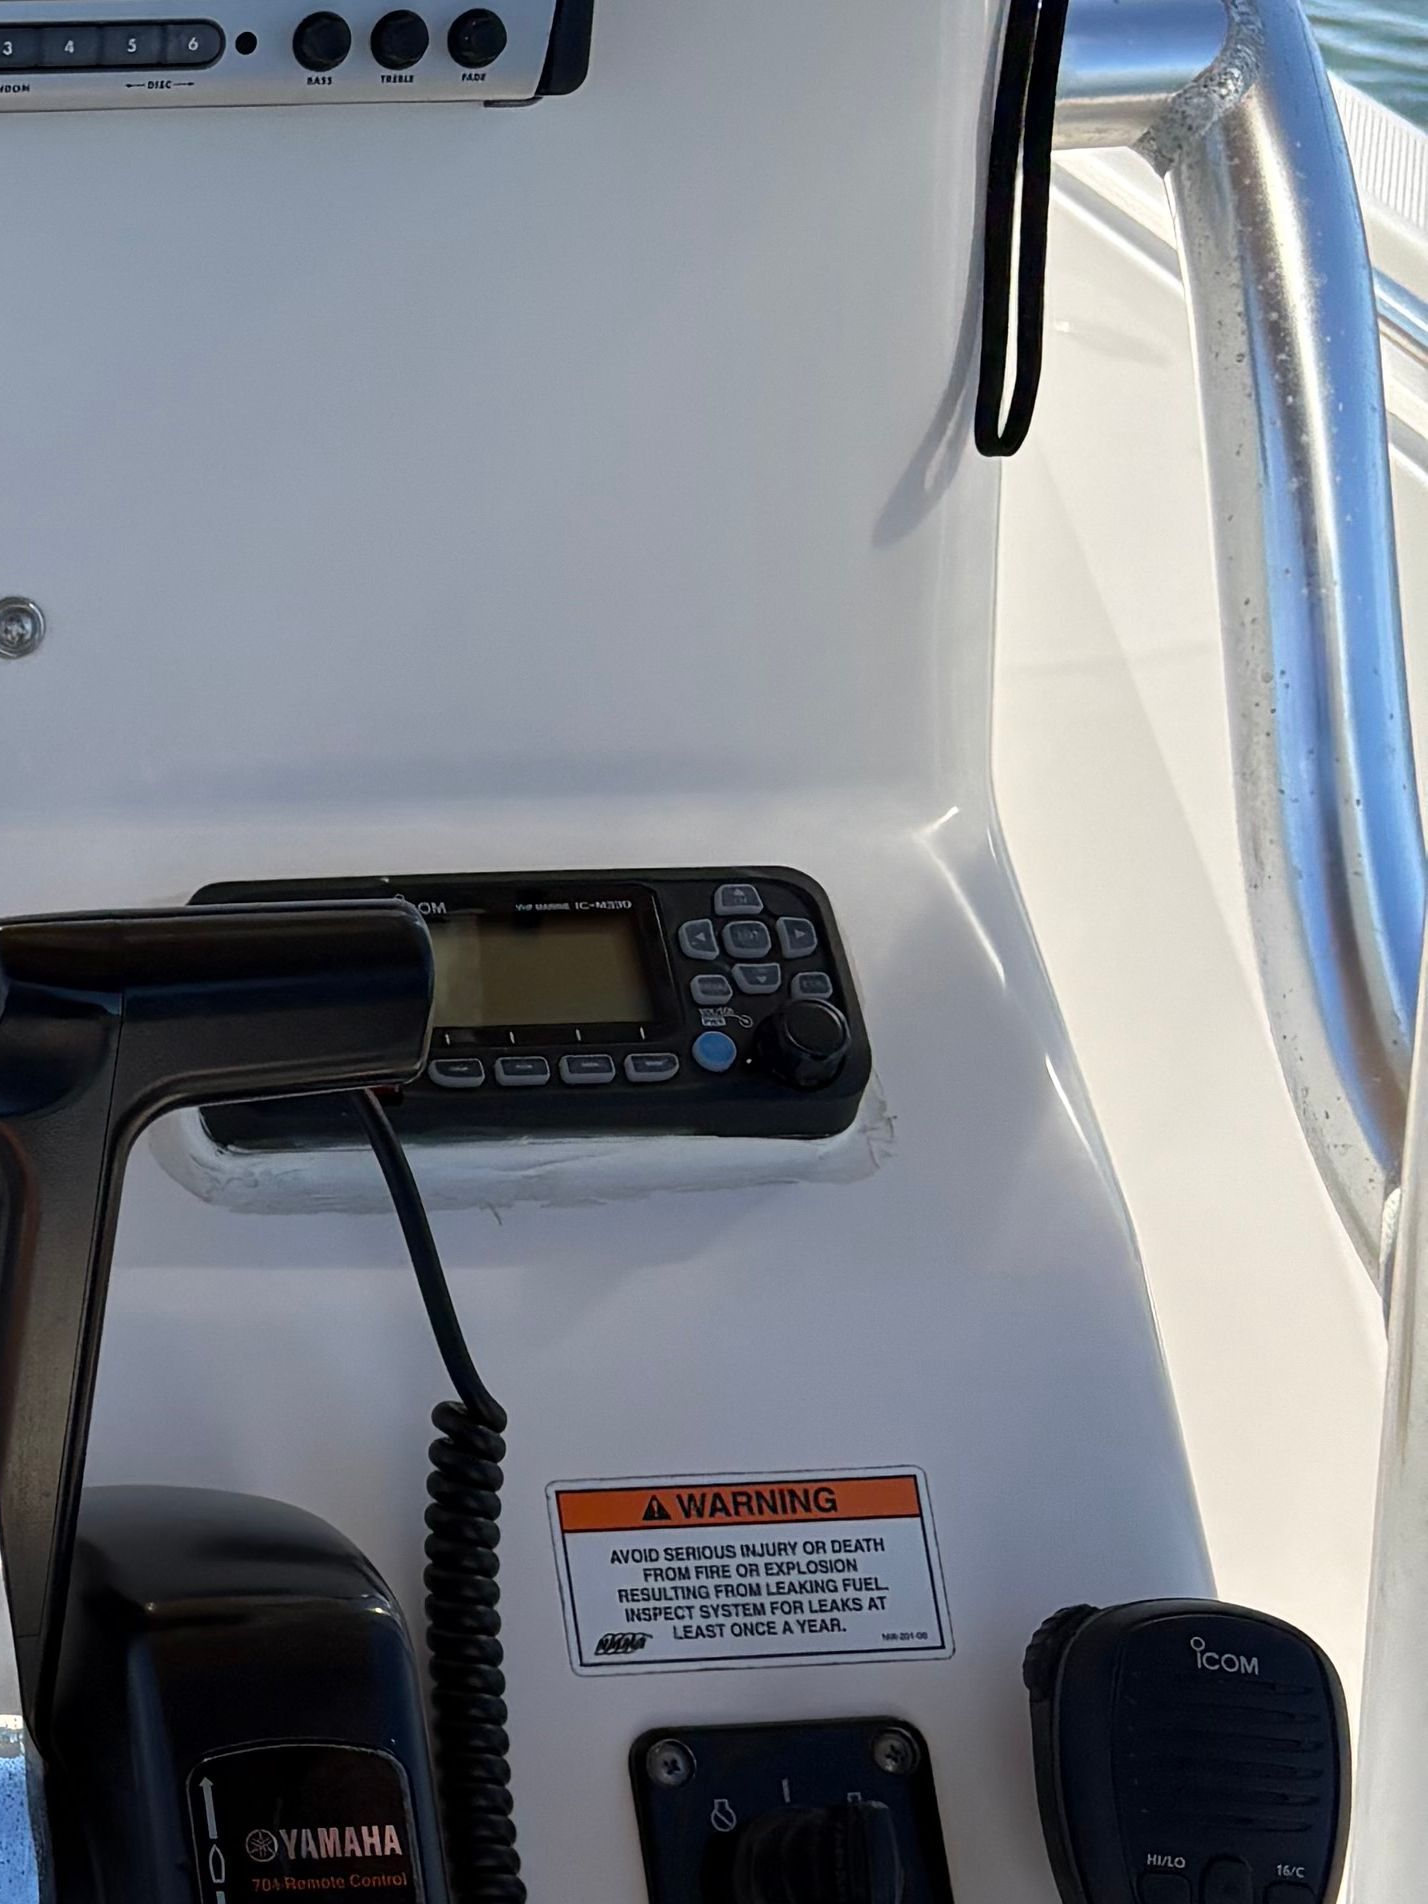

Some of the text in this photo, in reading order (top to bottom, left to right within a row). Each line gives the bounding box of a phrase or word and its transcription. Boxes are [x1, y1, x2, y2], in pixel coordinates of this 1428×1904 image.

[2, 41, 13, 57] 3
[64, 39, 75, 54] 4
[126, 38, 137, 53] 5
[187, 36, 199, 52] 6
[675, 1487, 838, 1520] WARNING
[609, 1537, 885, 1564] AVOID SERIOUS INJURY OR DEATH
[642, 1558, 858, 1582] FROM FIRE OR EXPLOSION
[617, 1585, 710, 1603] RESULTING
[714, 1582, 762, 1598] FROM
[766, 1579, 838, 1596] LEAKING
[624, 1596, 887, 1623] INSPECT SYSTEM FOR LEAKS AT
[672, 1617, 848, 1640] LEAST ONCE A YEAR.
[278, 1824, 403, 1860] YAMAHA
[1146, 1852, 1186, 1870] HI/LO
[1276, 1863, 1305, 1879] 16/C
[283, 1874, 345, 1890] Remote
[349, 1872, 408, 1888] Control
